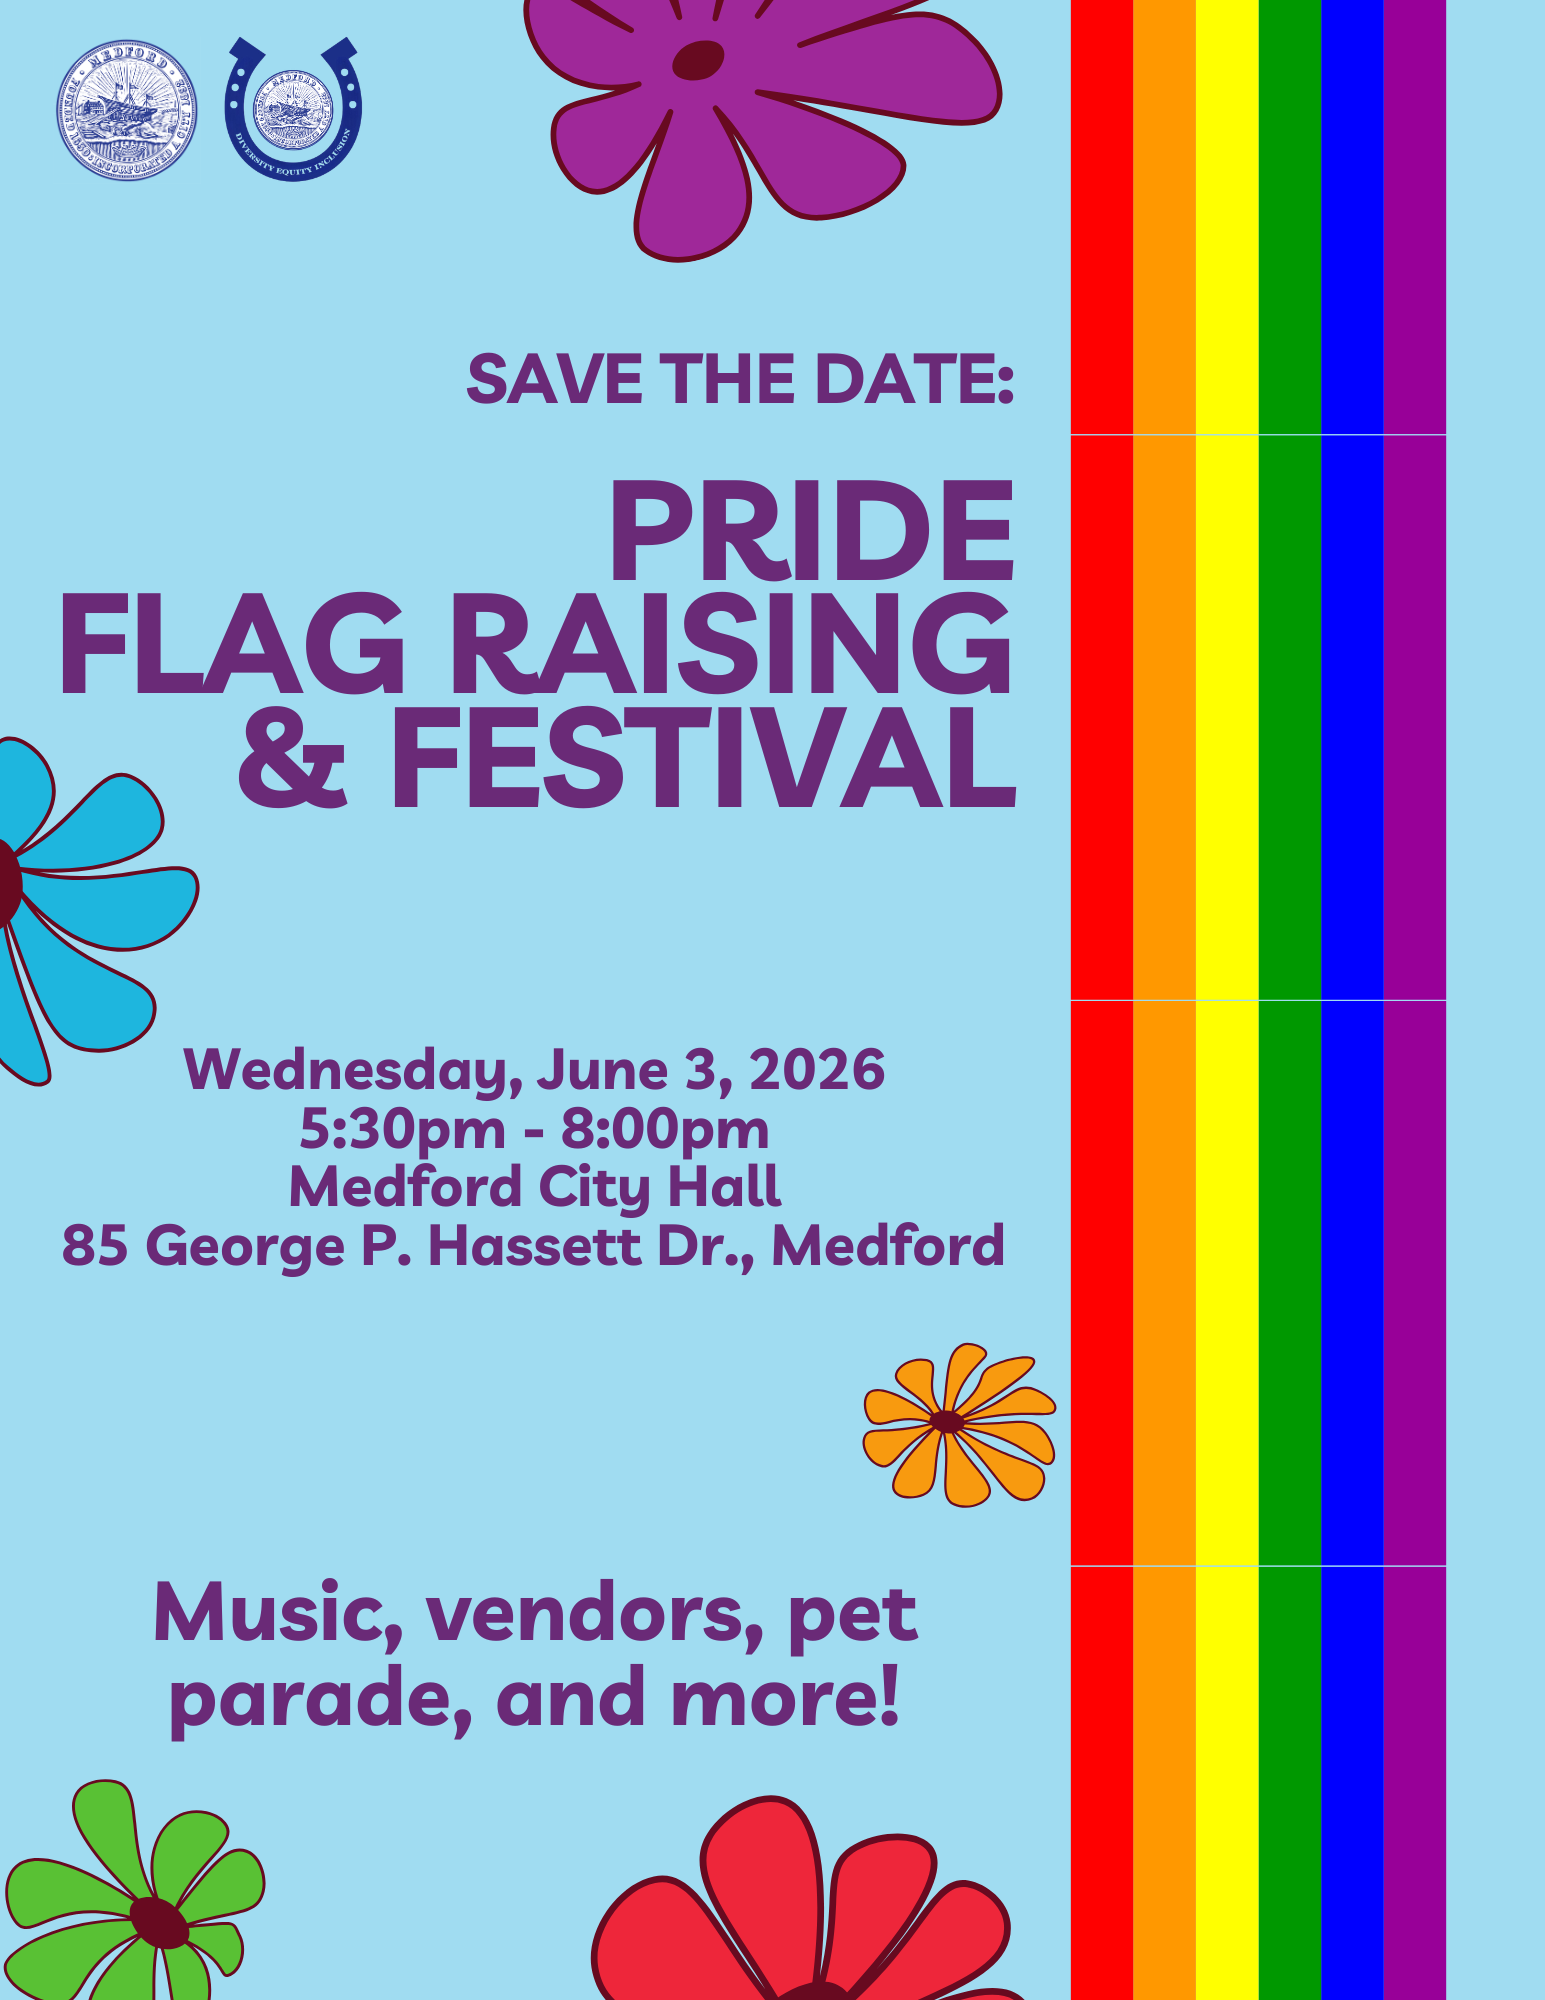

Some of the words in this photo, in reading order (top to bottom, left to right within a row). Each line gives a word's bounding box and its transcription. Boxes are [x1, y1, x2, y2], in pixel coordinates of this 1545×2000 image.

[88, 46, 168, 69] MEDFORD
[235, 132, 275, 172] DIVERSITY
[276, 166, 313, 176] EQUITY
[314, 128, 351, 170] INCLUSION
[467, 353, 642, 404] SAVE
[660, 353, 794, 403] THE
[818, 353, 1013, 404] DATE:
[613, 480, 1013, 581] PRIDE
[63, 592, 403, 694] FLAG
[454, 592, 1009, 694] RAISING
[239, 706, 347, 808] &
[395, 706, 1016, 808] FESTIVAL
[183, 1047, 522, 1101] Wednesday,
[537, 1048, 667, 1090] June
[686, 1048, 732, 1099] 3,
[750, 1048, 884, 1090] 2026
[300, 1107, 504, 1160] 5:30pm
[525, 1129, 543, 1137] -
[562, 1107, 768, 1160] 8:00pm
[291, 1163, 520, 1207] Medford
[540, 1163, 649, 1218] City
[670, 1164, 782, 1207] Hall
[63, 1224, 127, 1266] 85
[147, 1224, 344, 1277] George
[364, 1224, 410, 1266] P.
[431, 1224, 642, 1266] Hassett
[660, 1224, 753, 1275] Dr.,
[773, 1222, 1003, 1266] Medford
[156, 1578, 402, 1655] Music,
[426, 1579, 762, 1655] vendors,
[791, 1589, 918, 1657] pet
[172, 1664, 471, 1742] parade,
[497, 1664, 643, 1726] and
[674, 1664, 898, 1726] more!
